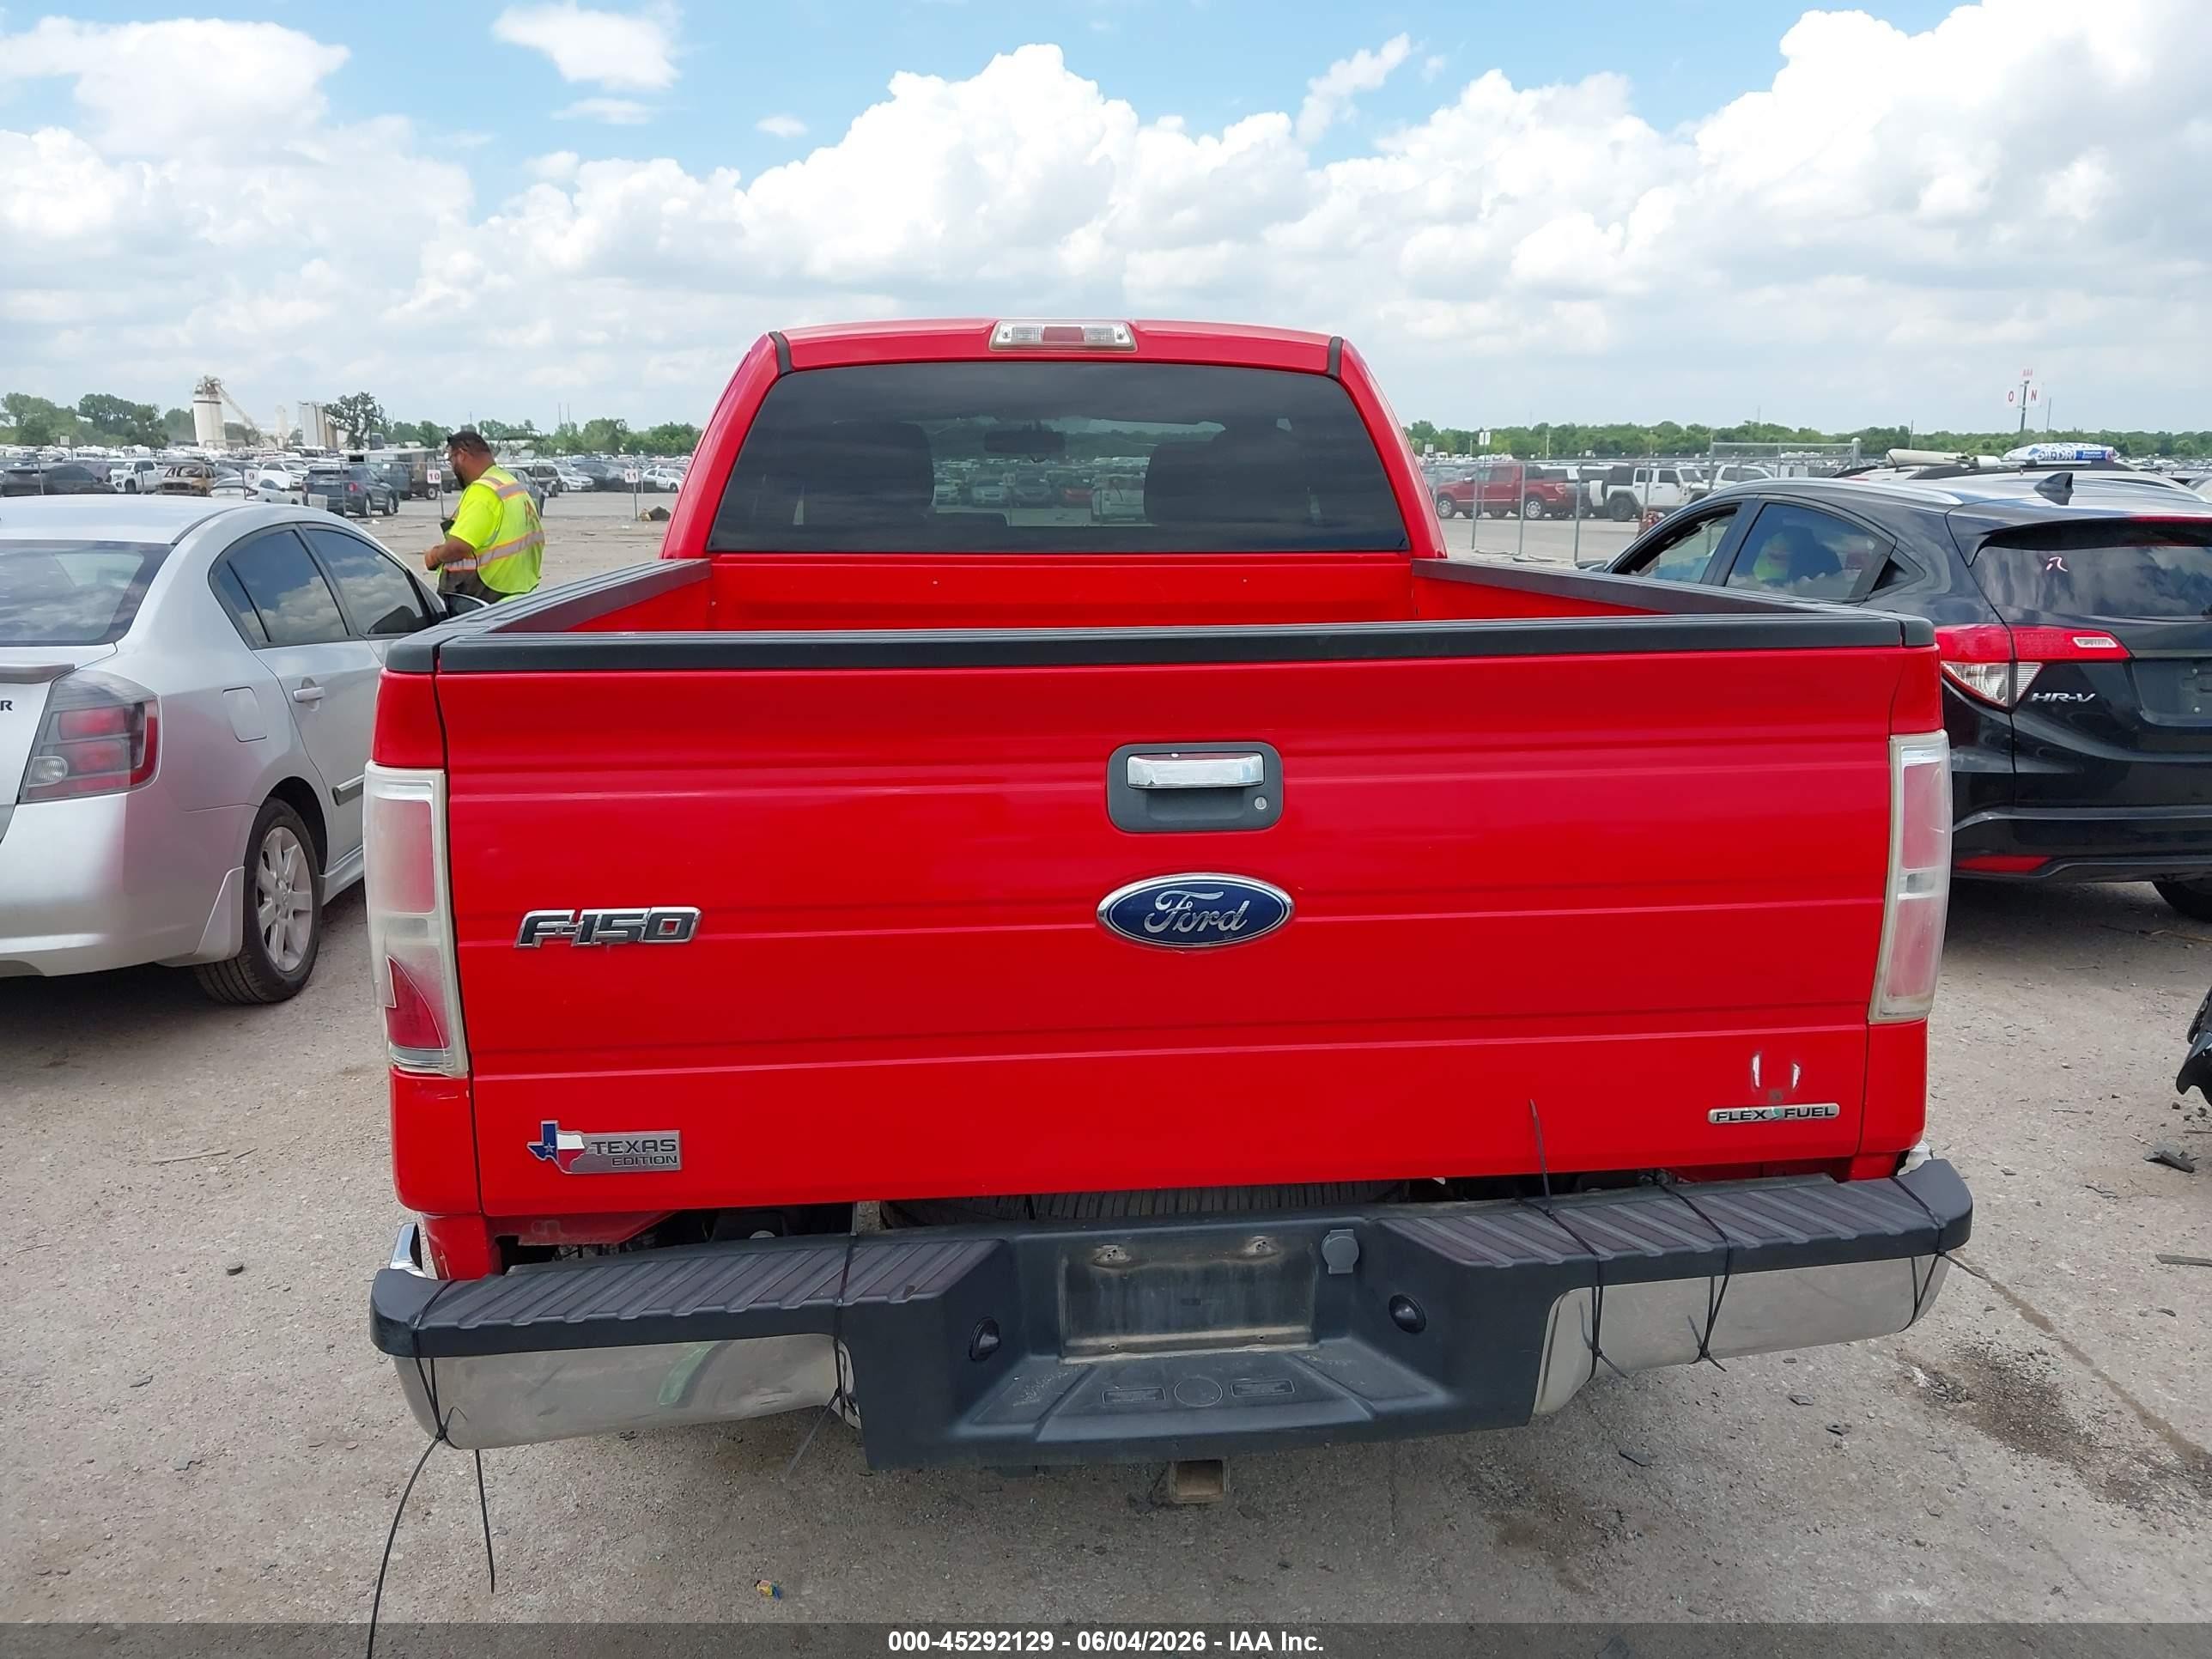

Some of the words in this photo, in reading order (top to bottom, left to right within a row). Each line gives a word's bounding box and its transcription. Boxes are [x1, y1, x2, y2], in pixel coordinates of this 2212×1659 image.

[2031, 692, 2096, 702] HR-V
[1144, 890, 1250, 933] Ford
[514, 906, 702, 948] F-150
[1716, 1109, 1767, 1121] FLEX
[1784, 1107, 1835, 1119] FUEL
[591, 1139, 677, 1155] TEXAS
[611, 1154, 678, 1167] EDITION
